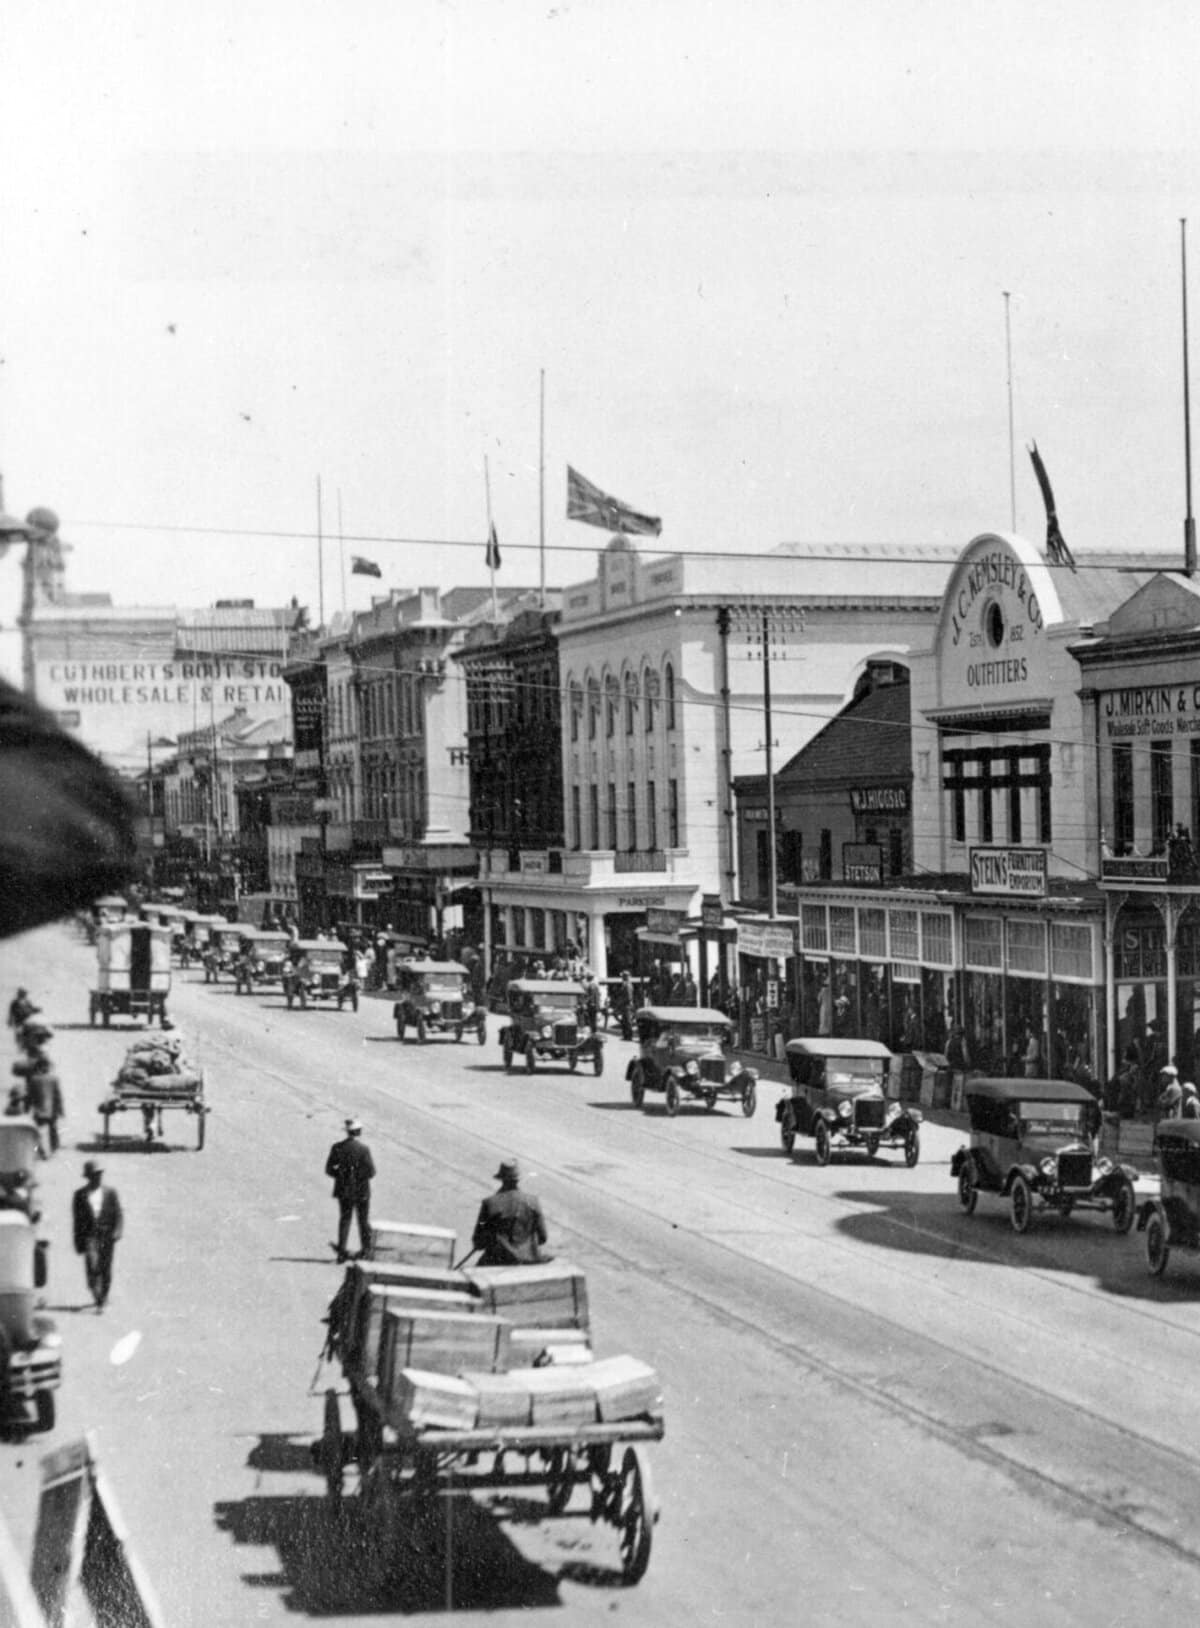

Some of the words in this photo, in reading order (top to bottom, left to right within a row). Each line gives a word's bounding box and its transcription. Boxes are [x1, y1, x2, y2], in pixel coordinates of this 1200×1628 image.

[968, 552, 1018, 601] KEMSLEY
[244, 661, 282, 680] STO
[967, 656, 1028, 687] OUTFITTERS
[63, 686, 191, 703] WHOLESALE
[201, 687, 213, 703] &
[224, 685, 284, 703] RETAI
[1177, 690, 1187, 713] &
